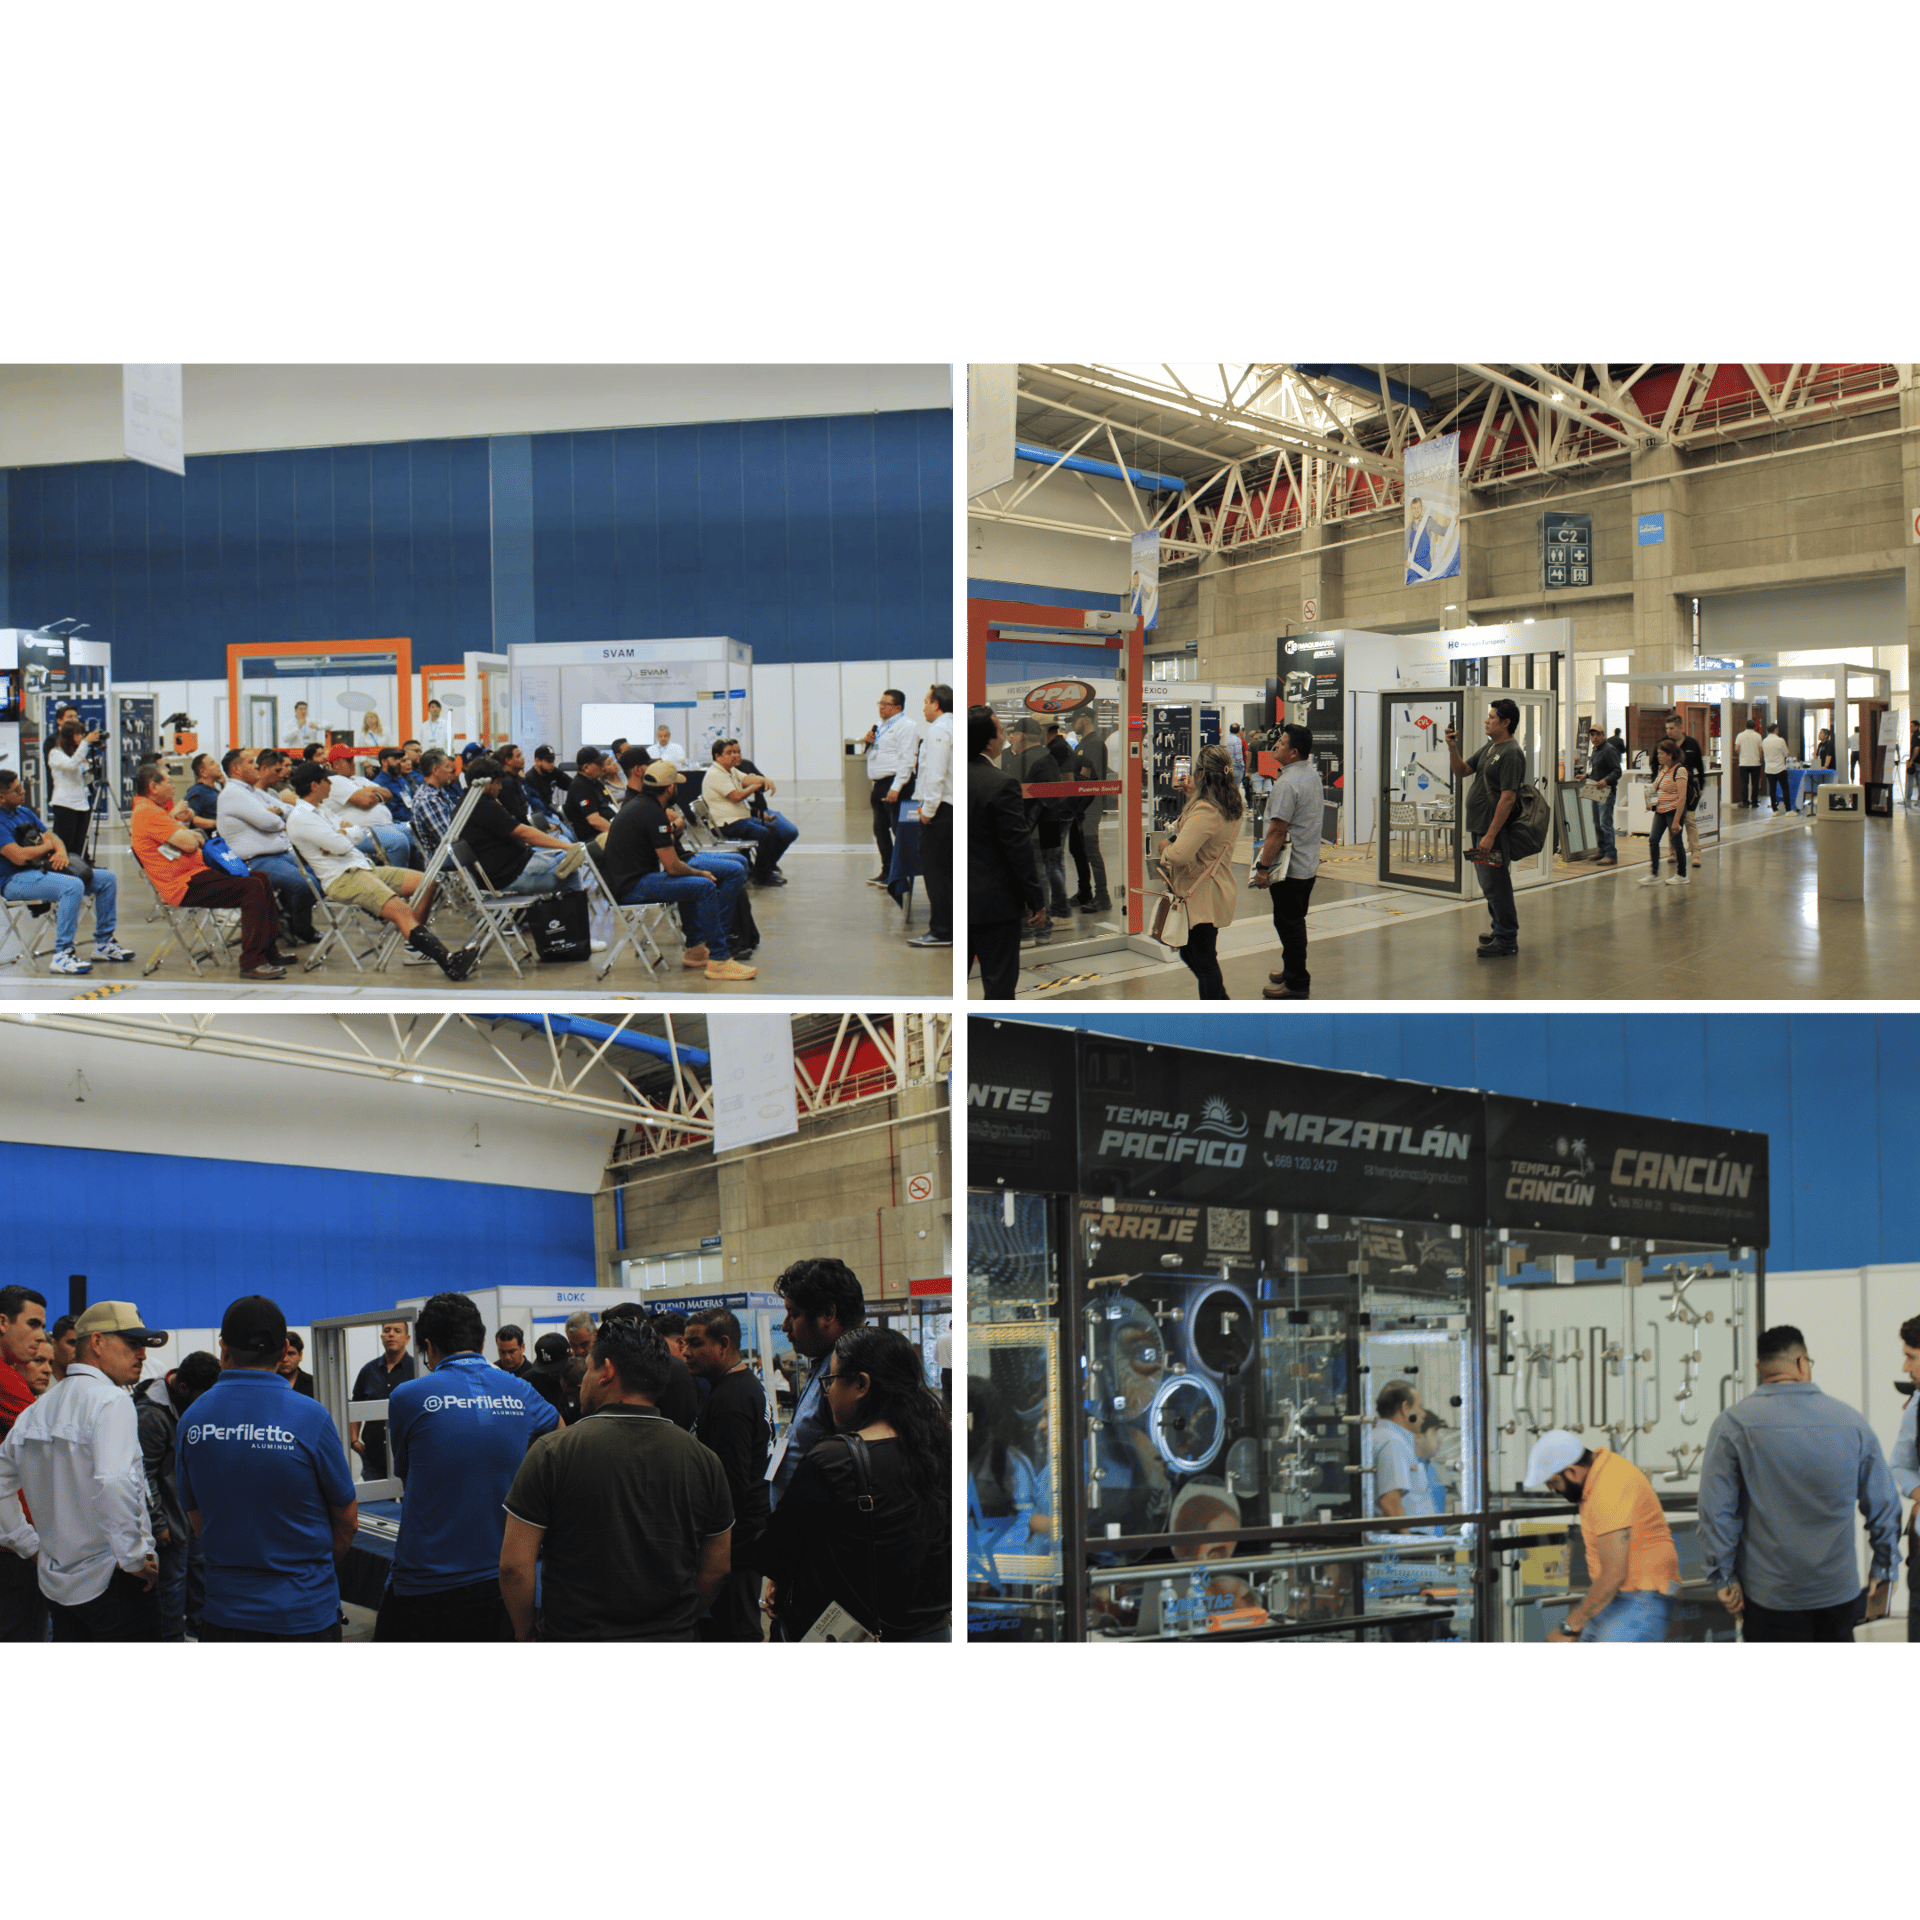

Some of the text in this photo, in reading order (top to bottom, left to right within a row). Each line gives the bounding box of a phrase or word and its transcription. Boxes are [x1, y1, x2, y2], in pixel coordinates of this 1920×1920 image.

[1558, 530, 1578, 542] C2
[603, 649, 635, 658] SVAM
[640, 669, 668, 677] SVAM
[1028, 685, 1082, 702] PPA
[1105, 785, 1120, 793] Social
[1105, 1105, 1190, 1130] TEMPLA
[1264, 1110, 1471, 1160] MAZATLÁN
[1098, 1129, 1248, 1168] PACÍFICO
[1295, 1157, 1312, 1170] 120
[1313, 1158, 1325, 1171] 24
[1326, 1160, 1338, 1173] 27
[1510, 1161, 1561, 1178] TEMPLA
[1611, 1148, 1753, 1199] CANCÚN
[1505, 1177, 1596, 1206] CANCÚN
[1185, 1207, 1200, 1217] DE
[557, 1293, 585, 1302] BLOKC
[686, 1298, 724, 1309] MADERAS
[444, 1396, 524, 1410] Perfiletto
[202, 1423, 295, 1443] Perfiletto
[251, 1443, 295, 1451] ALUMINUM
